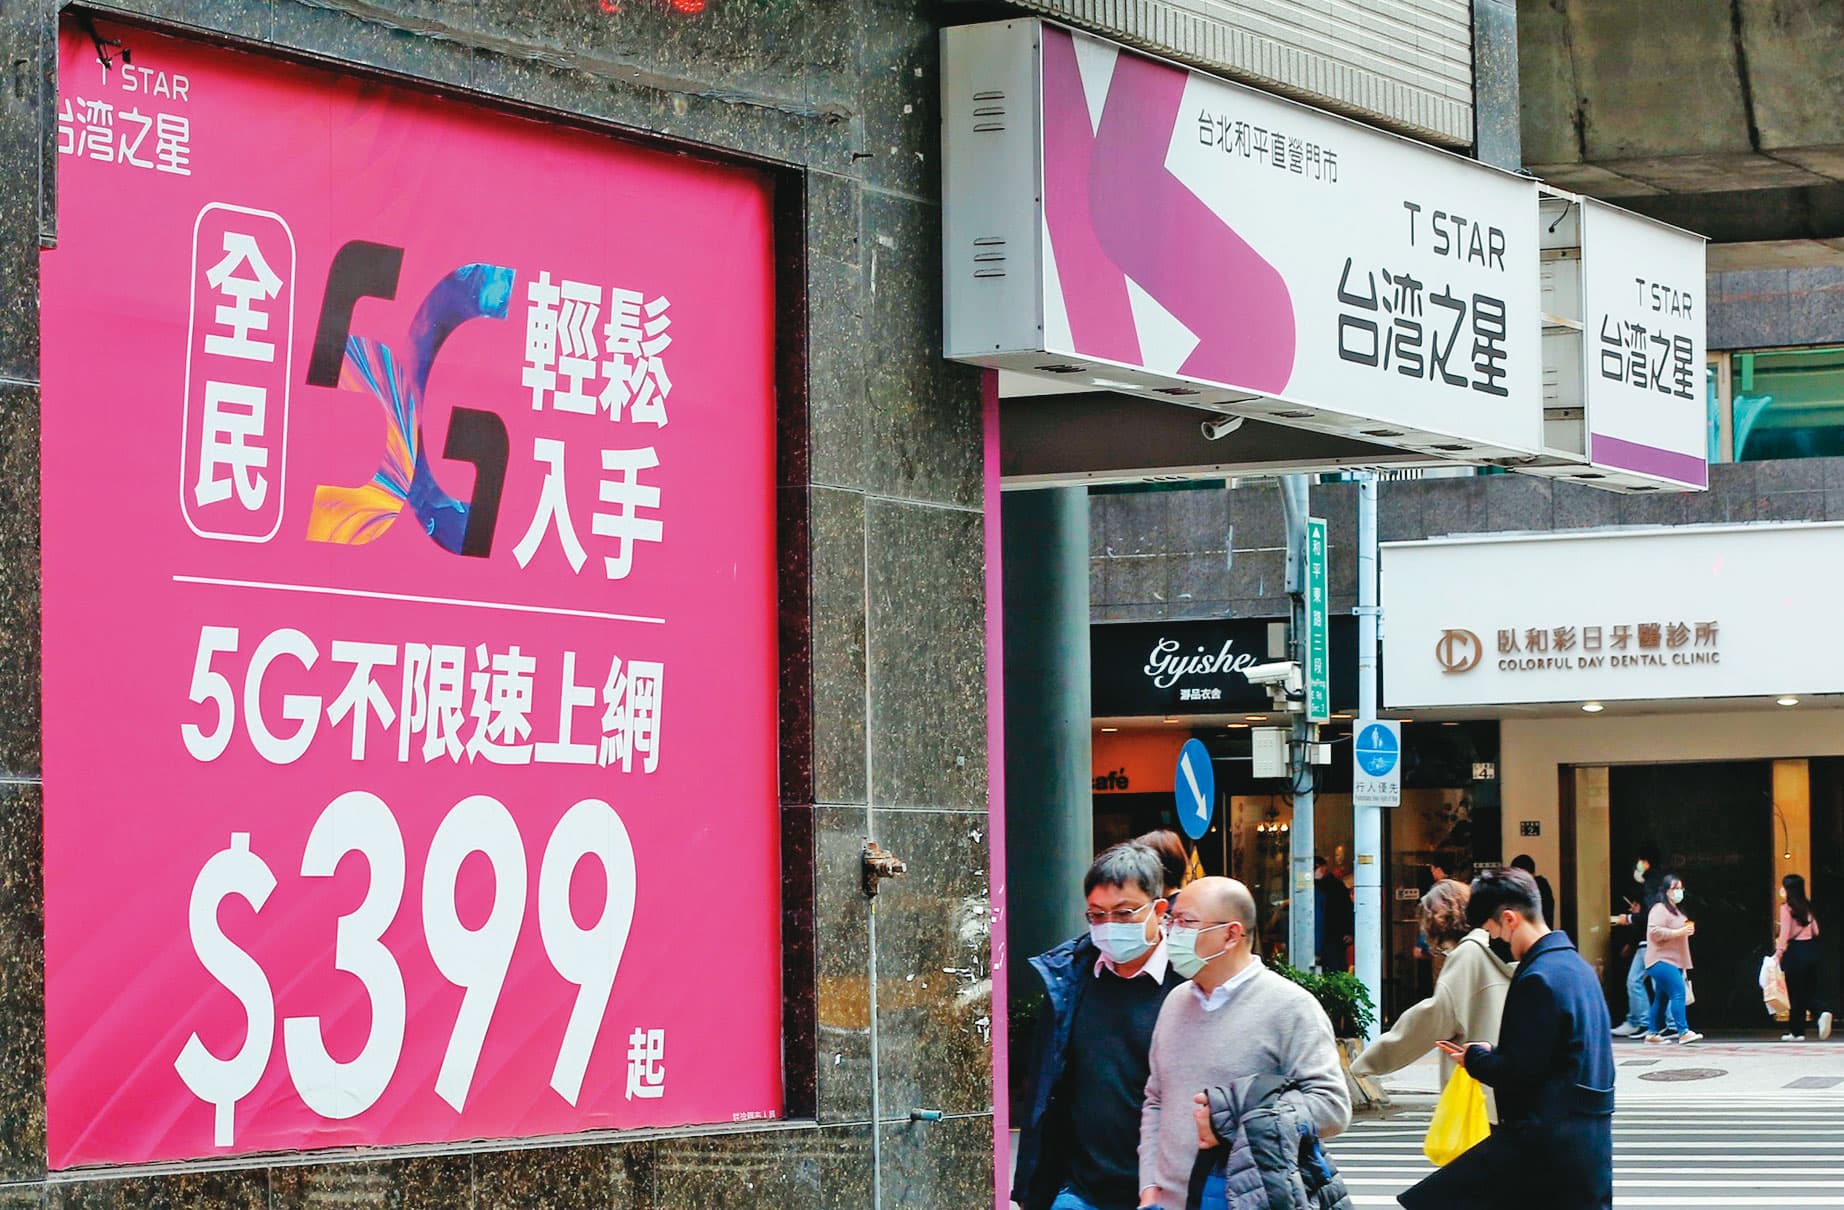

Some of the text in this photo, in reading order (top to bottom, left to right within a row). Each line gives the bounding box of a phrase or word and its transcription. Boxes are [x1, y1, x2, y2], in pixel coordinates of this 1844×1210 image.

[96, 58, 190, 102] T STAR
[1198, 108, 1338, 184] 台北和平直營門市
[1403, 200, 1506, 272] T STAR
[1336, 256, 1509, 398] 台湾之星
[1635, 277, 1693, 321] T STAR
[194, 231, 284, 512] 全民
[521, 270, 673, 429] 輕鬆
[1599, 313, 1695, 402] 台湾之星
[305, 239, 516, 558] 5G
[511, 436, 664, 580] 入手
[180, 625, 666, 775] 5G不限速上網
[1144, 637, 1257, 688] Gyishe
[1498, 652, 1720, 671] COLORFUL DAY DENTAL CLINIC
[1092, 768, 1128, 790] afé
